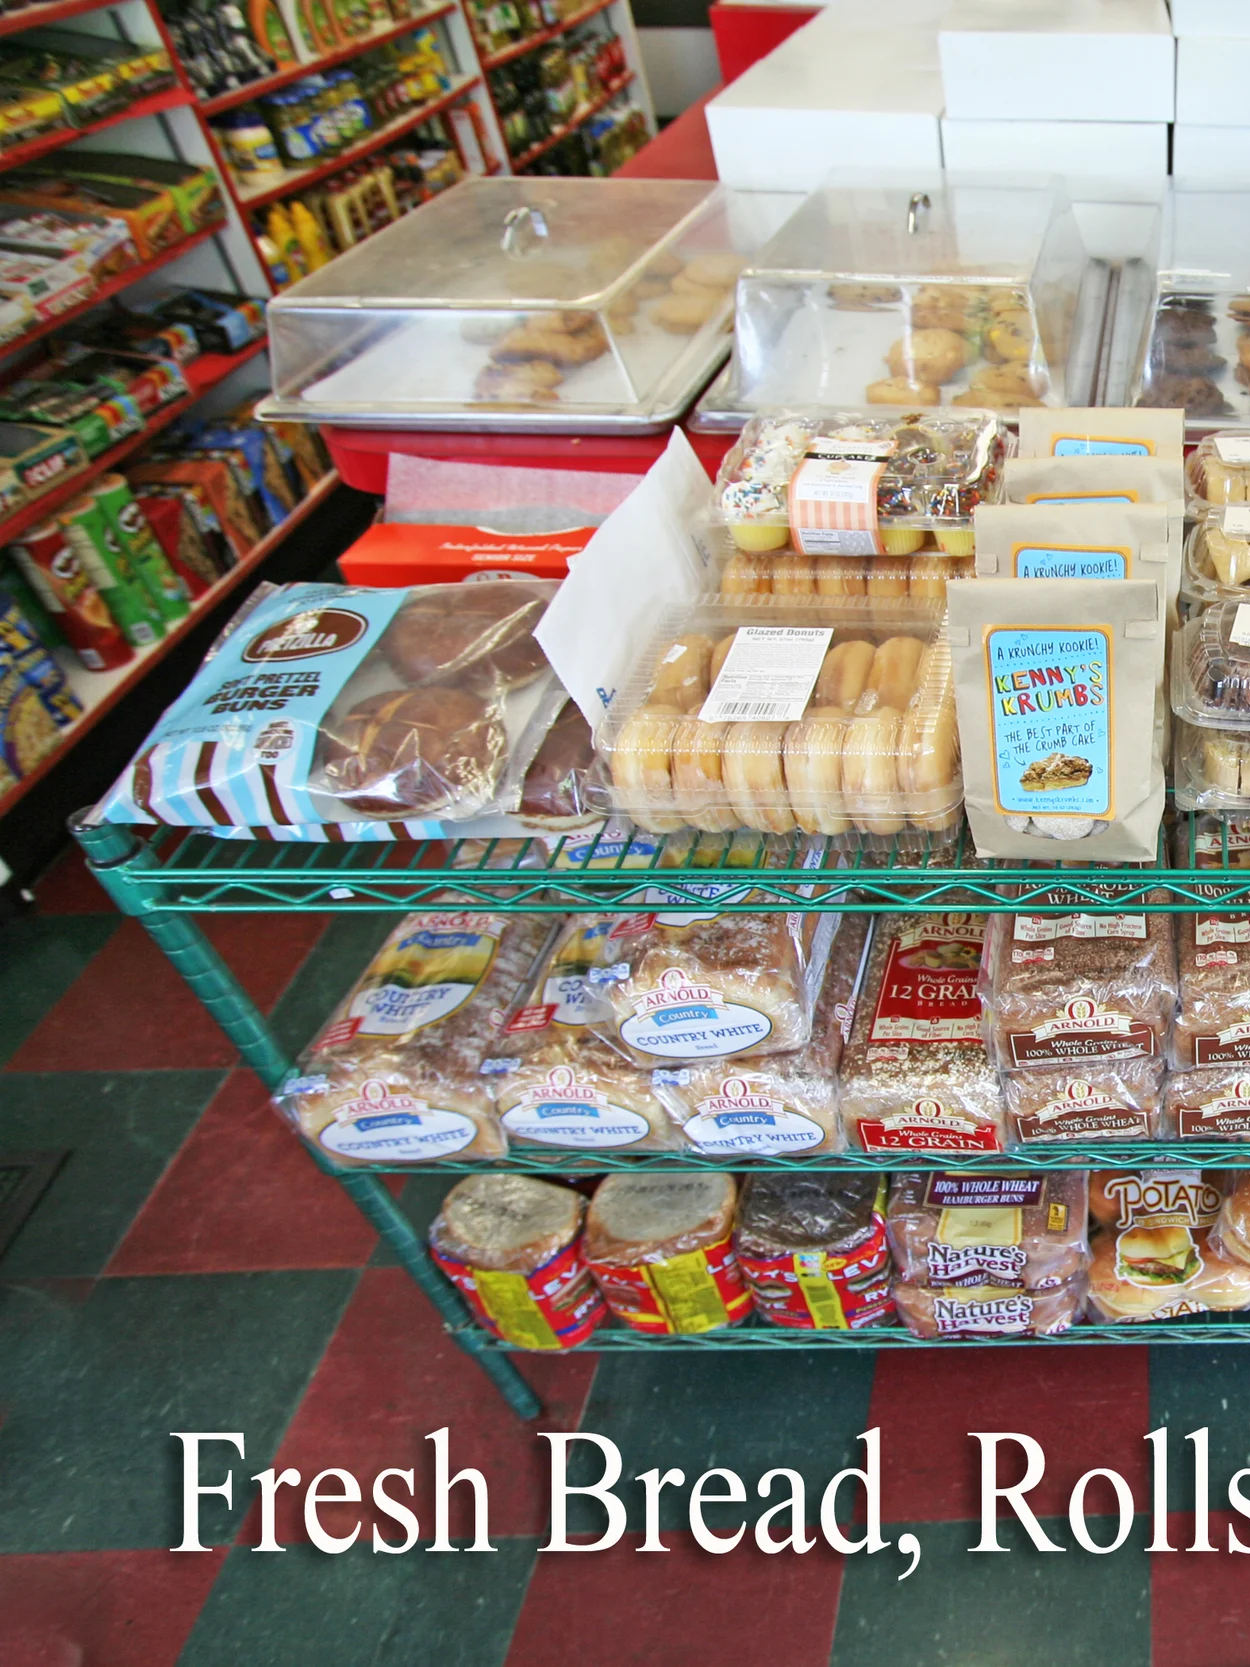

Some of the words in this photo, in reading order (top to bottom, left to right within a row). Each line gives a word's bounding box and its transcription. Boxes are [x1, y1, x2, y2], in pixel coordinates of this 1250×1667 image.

[1034, 563, 1077, 578] KRUNCHY
[1080, 558, 1118, 576] KOOKIE!
[746, 628, 784, 636] Glazed
[786, 628, 825, 636] Donuts
[997, 646, 1005, 660] A
[1009, 641, 1055, 660] KRUNCHY
[1059, 638, 1100, 654] KOOKIE!
[254, 671, 322, 685] PRETZEL
[995, 661, 1104, 694] KENNY'S
[203, 684, 321, 706] BURGER
[1001, 682, 1105, 718] KRUMBS
[211, 699, 290, 715] BUNS
[1004, 731, 1022, 744] THE
[1027, 726, 1052, 742] BEST
[1055, 722, 1076, 737] PART
[1083, 720, 1097, 733] OF
[1012, 741, 1031, 755] THE
[1035, 737, 1068, 751] CRUMB
[1071, 734, 1096, 747] CAKE
[917, 974, 946, 984] Whole
[645, 990, 710, 1007] ARNOLD
[889, 985, 913, 1000] 12
[658, 1008, 709, 1024] Country
[1050, 1017, 1115, 1031] ARNOLD
[637, 1032, 709, 1047] COUNTRY
[712, 1024, 764, 1040] WHITE
[1051, 1040, 1082, 1048] Whole
[1026, 1049, 1053, 1058] 100%
[1055, 1046, 1099, 1056] WHOLE
[1208, 1053, 1235, 1061] 100%
[531, 1087, 594, 1100] ARNOLD
[348, 1100, 413, 1114] ARNOLD
[541, 1104, 591, 1116] Country
[707, 1097, 771, 1111] ARNOLD
[1052, 1096, 1114, 1113] ARNOLD
[360, 1116, 413, 1129] Country
[720, 1114, 768, 1126] Country
[897, 1116, 961, 1127] ARNOLD
[1054, 1117, 1083, 1126] Whole
[1085, 1114, 1117, 1123] Grains
[1058, 1122, 1099, 1132] WHOLE
[1101, 1117, 1140, 1127] WHEAT
[1215, 1117, 1245, 1126] Whole
[516, 1125, 586, 1137] COUNTRY
[588, 1124, 642, 1136] WHITE
[898, 1130, 929, 1138] Whole
[931, 1131, 963, 1140] Grains
[337, 1137, 412, 1152] COUNTRY
[414, 1128, 470, 1144] WHITE
[766, 1132, 817, 1144] WHITE
[880, 1136, 902, 1146] 12
[908, 1137, 985, 1149] GRAIN
[934, 1181, 959, 1193] 100%
[962, 1181, 1001, 1193] WHOLE
[1001, 1181, 1040, 1193] WHEAT
[942, 1195, 999, 1205] HAMBURGER
[1000, 1194, 1025, 1203] BUNS
[1107, 1178, 1220, 1228] POTATO
[929, 1243, 1026, 1264] Nature's
[931, 1257, 1020, 1277] Harvest
[955, 1273, 989, 1287] WHOLE
[936, 1295, 1033, 1320] Nature's
[938, 1313, 1030, 1332] Harvest
